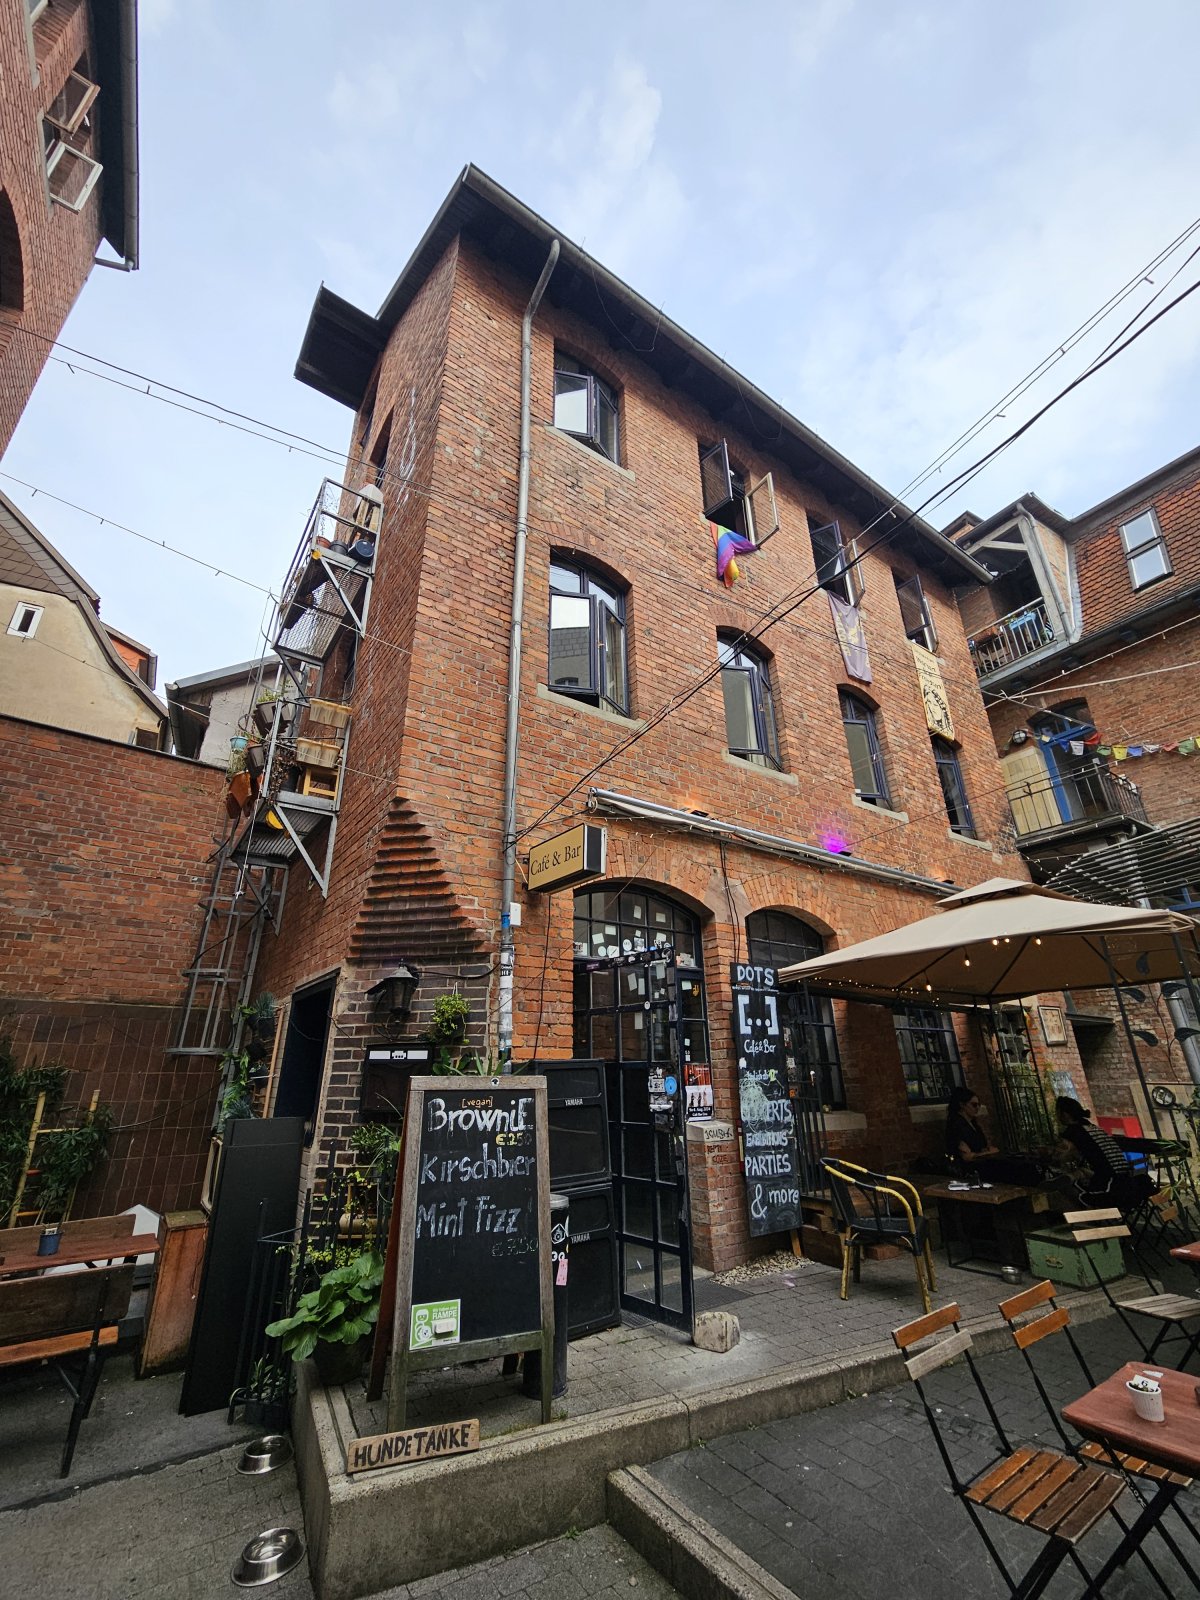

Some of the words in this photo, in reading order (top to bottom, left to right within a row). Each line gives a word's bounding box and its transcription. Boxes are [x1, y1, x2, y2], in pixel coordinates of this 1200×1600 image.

[530, 854, 550, 876] Café
[552, 851, 561, 867] &
[564, 845, 582, 863] Bar
[737, 965, 774, 987] DOTS
[565, 1098, 584, 1106] YAMAHA
[421, 1143, 535, 1184] Kirschbier
[751, 1184, 767, 1219] &
[769, 1188, 799, 1204] more
[416, 1198, 467, 1239] Mint
[571, 1232, 590, 1244] YAMAHA
[432, 1310, 458, 1320] RAMPE
[354, 1423, 471, 1467] HUNDETANKE
